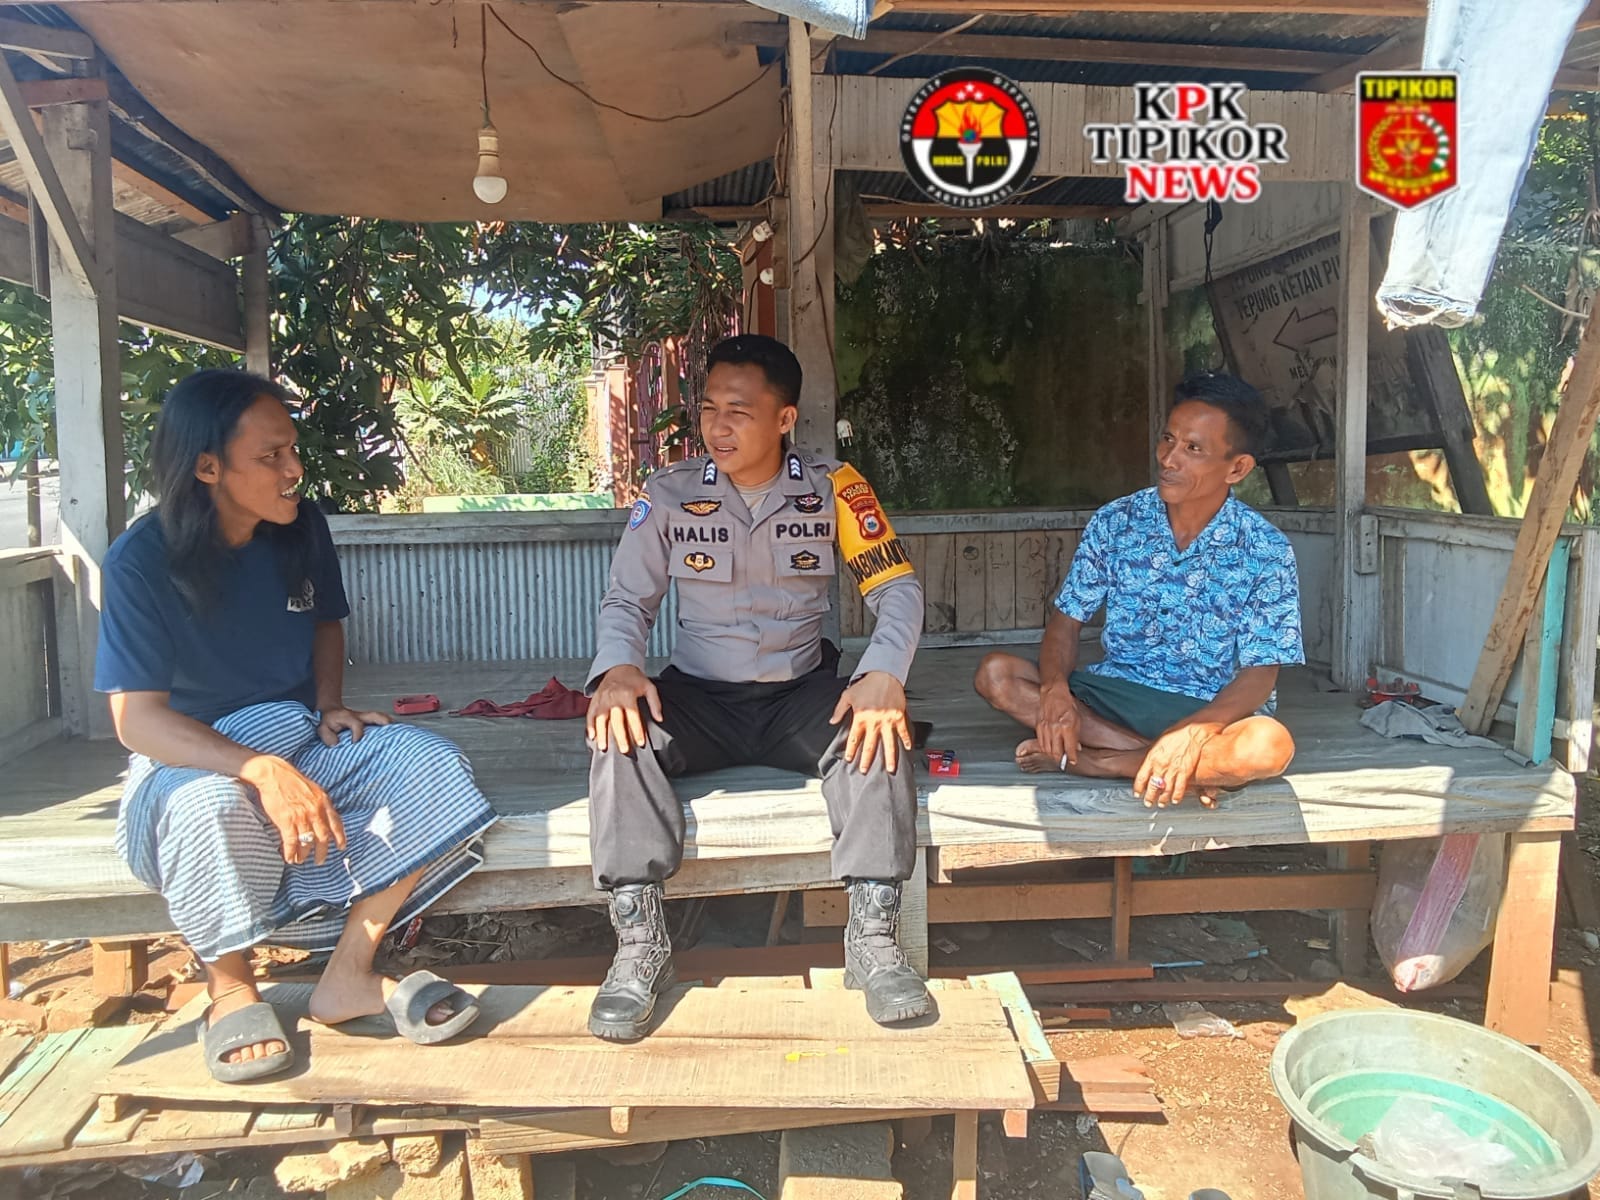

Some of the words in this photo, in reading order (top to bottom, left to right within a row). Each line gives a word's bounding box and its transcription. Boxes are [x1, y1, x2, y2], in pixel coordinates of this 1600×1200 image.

[1234, 284, 1281, 320] TEPUNG
[1279, 263, 1324, 303] KETAN
[673, 526, 729, 543] HALIS
[776, 521, 831, 539] POLRI
